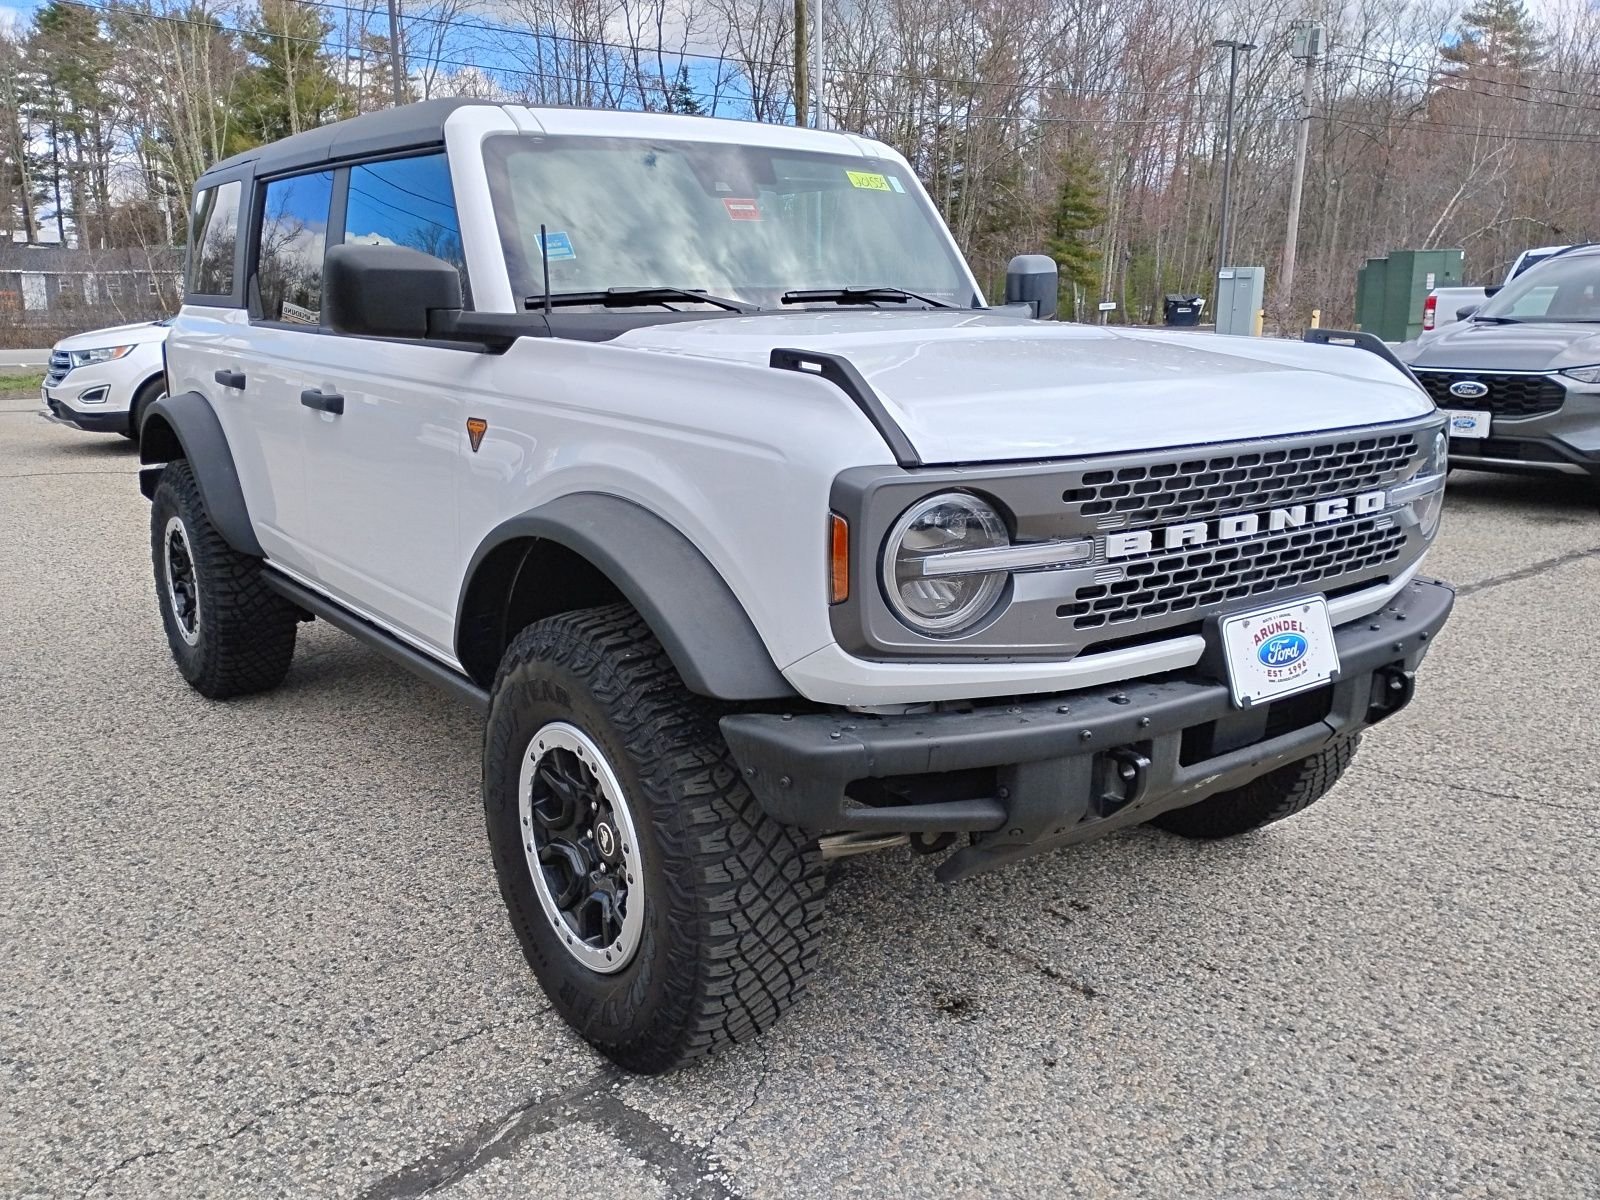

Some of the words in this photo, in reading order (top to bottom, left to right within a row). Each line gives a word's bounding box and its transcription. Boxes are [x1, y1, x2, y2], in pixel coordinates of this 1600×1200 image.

[1457, 384, 1479, 395] Ford
[1105, 490, 1386, 558] BRONCO
[1254, 620, 1305, 646] ARUNDEL
[1268, 639, 1299, 663] Ford
[1267, 669, 1283, 678] EST
[1288, 660, 1307, 675] 1996
